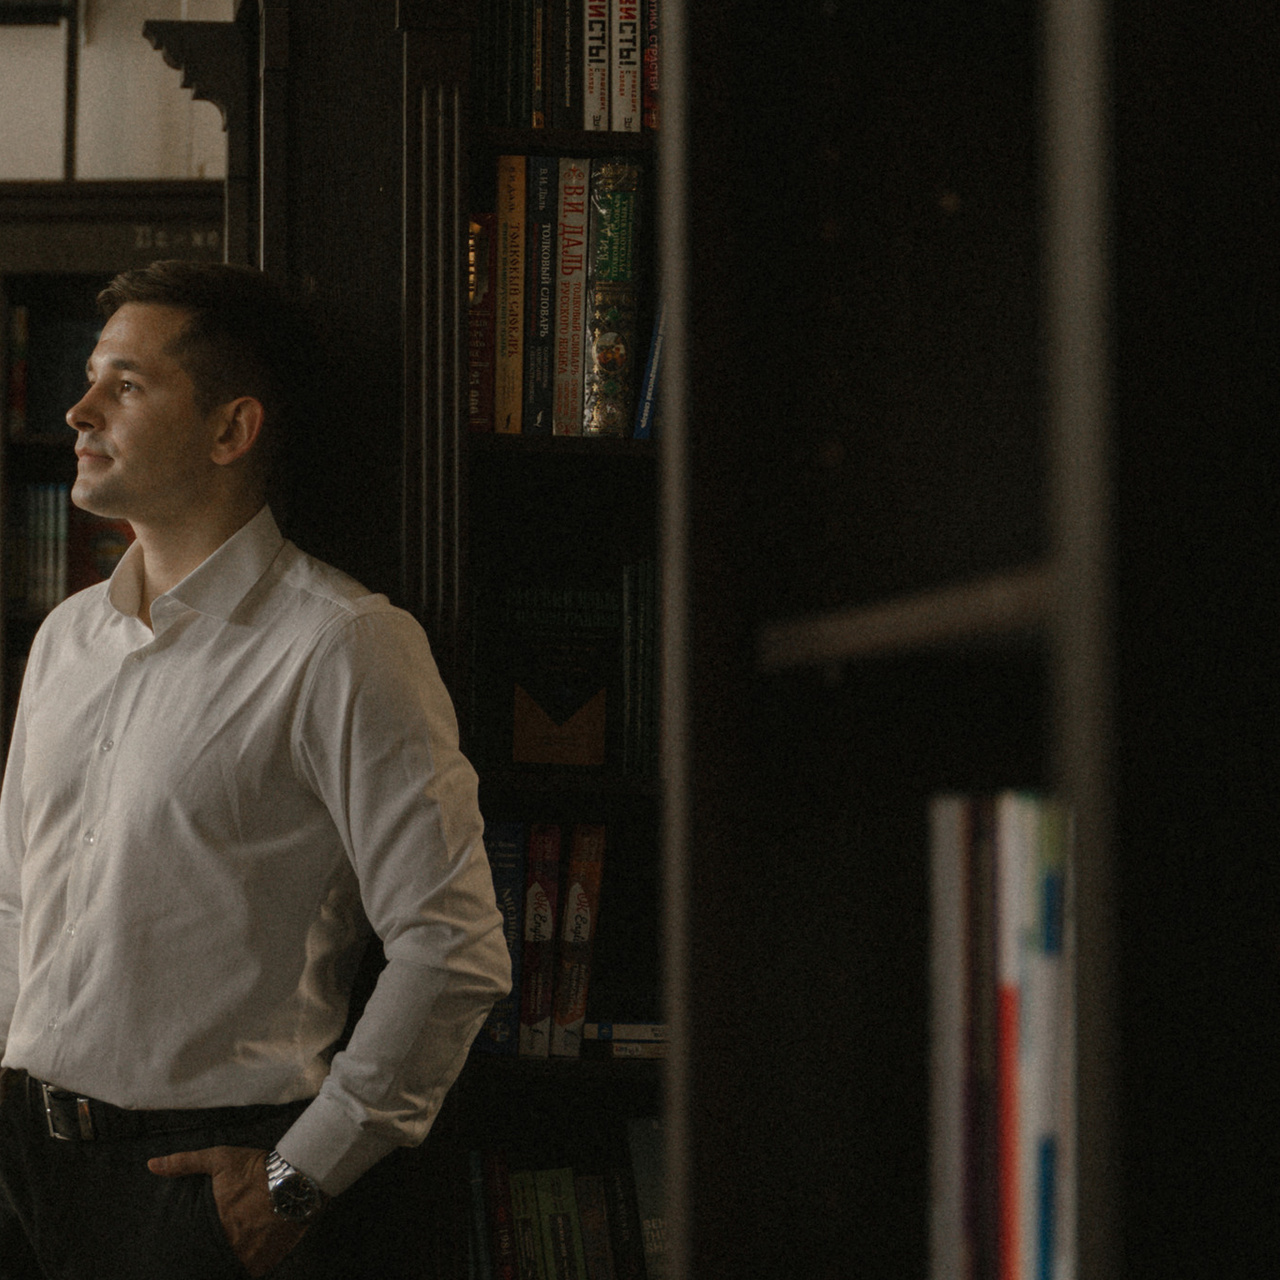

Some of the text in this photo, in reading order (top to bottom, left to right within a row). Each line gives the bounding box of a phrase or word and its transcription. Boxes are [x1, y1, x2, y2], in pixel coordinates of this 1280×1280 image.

[558, 184, 585, 276] В.И. ДАЛЬ
[619, 229, 628, 273] РУССКОГО
[539, 222, 552, 337] ТОЛКОВЫЙ СЛОВАРЬ
[558, 281, 571, 374] РУССКОГО ЯЗЫКА
[571, 282, 582, 376] ТОЛКОВЫЙ СЛОВАРЬ
